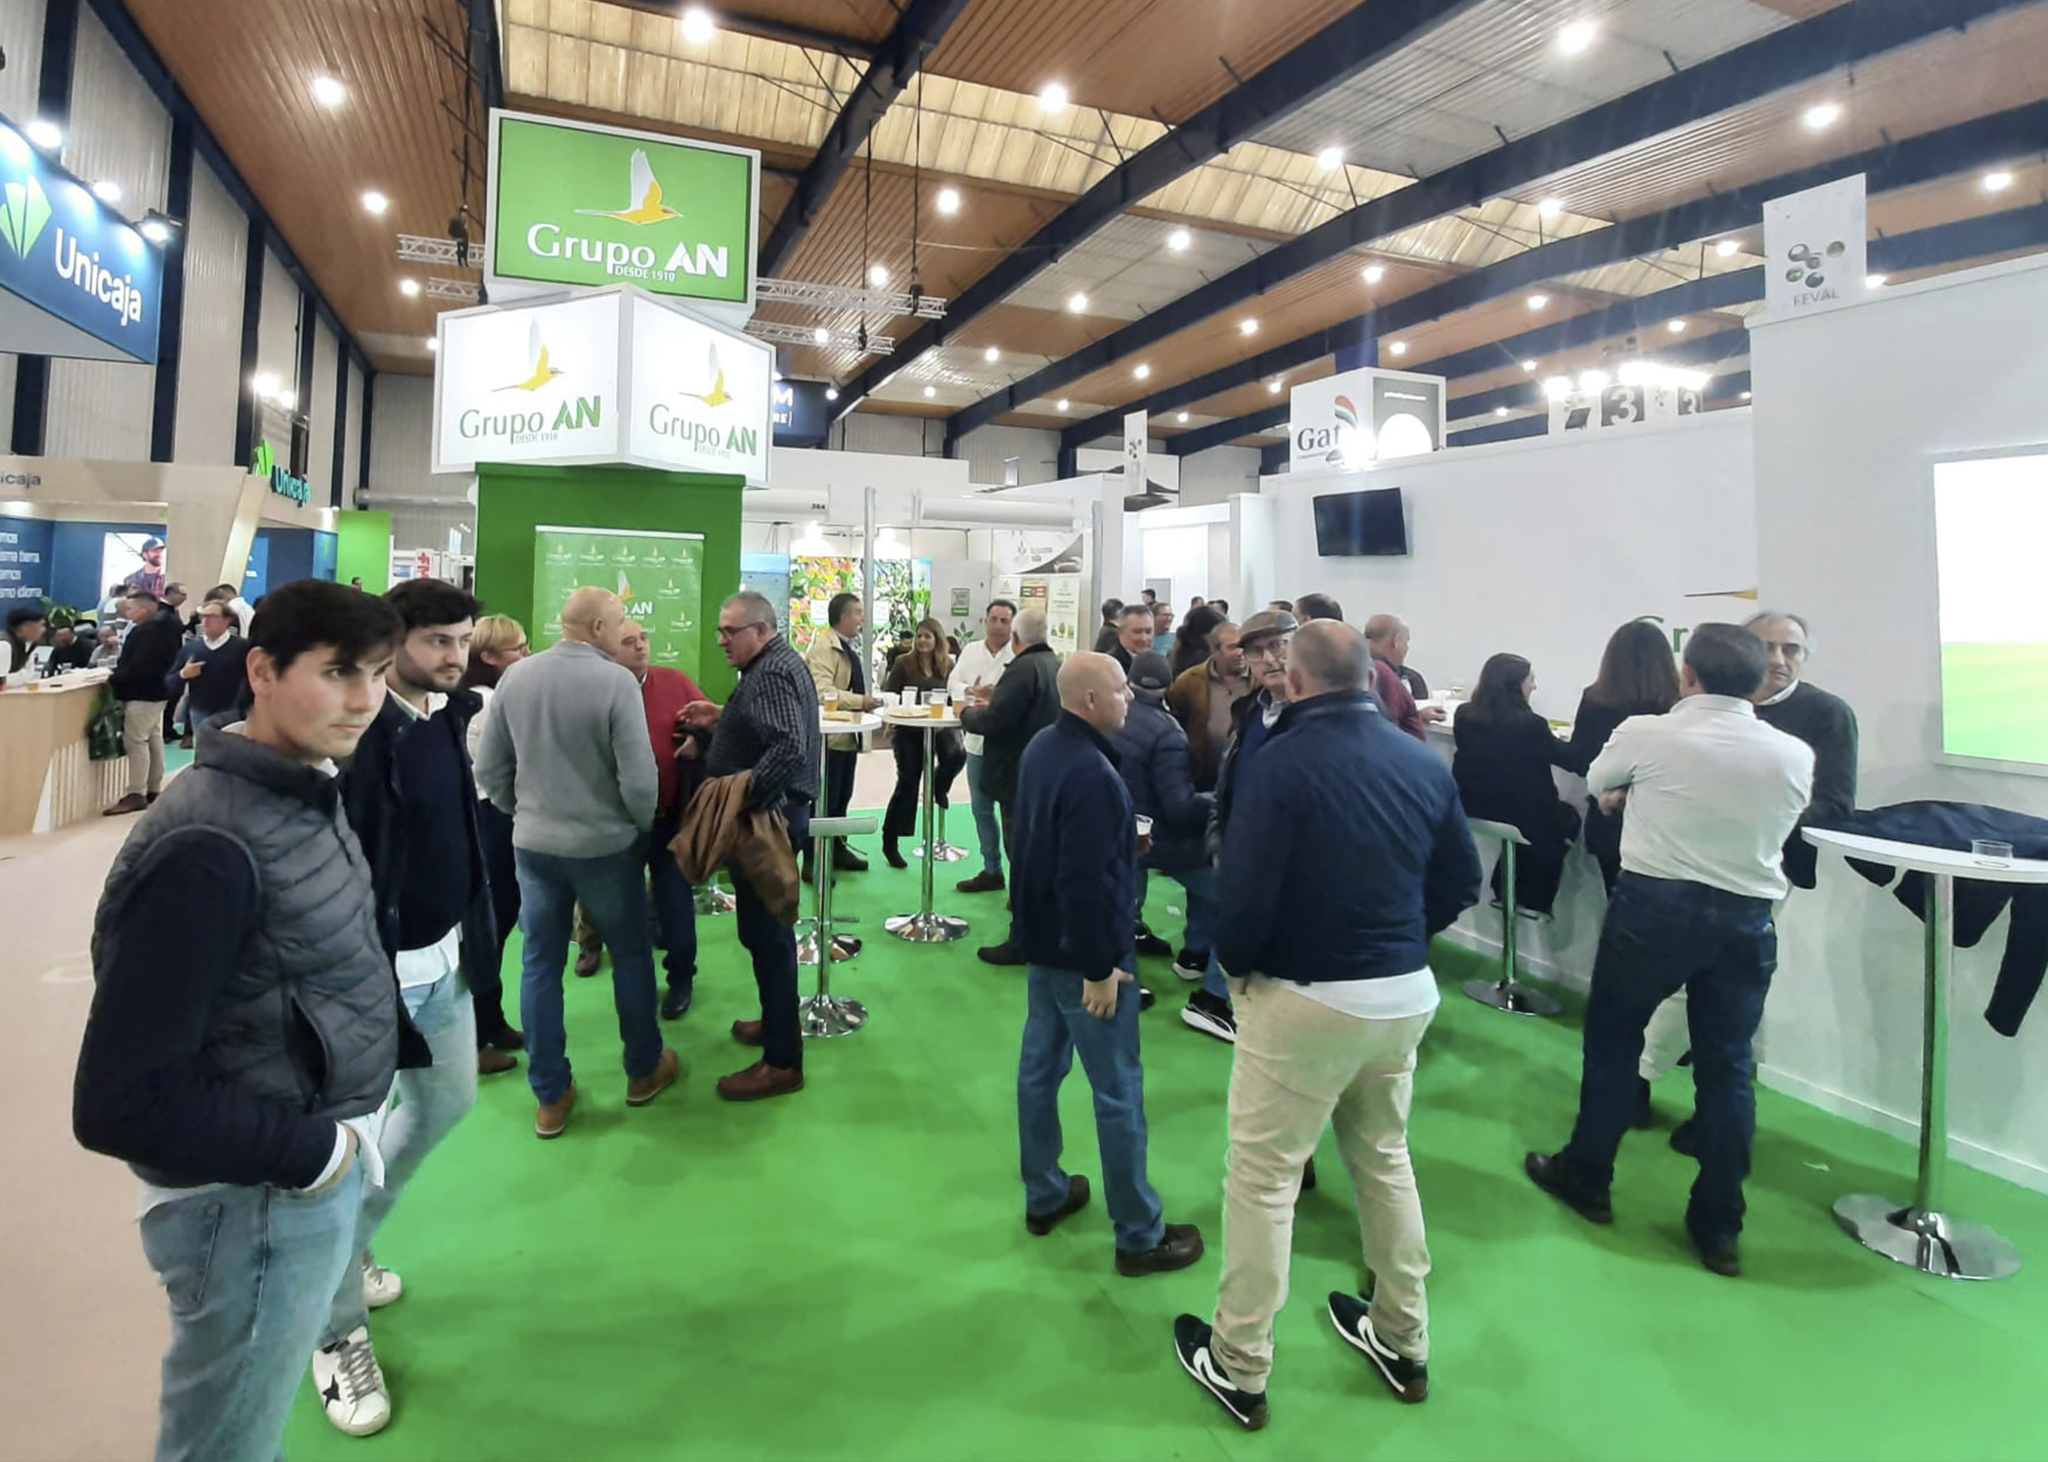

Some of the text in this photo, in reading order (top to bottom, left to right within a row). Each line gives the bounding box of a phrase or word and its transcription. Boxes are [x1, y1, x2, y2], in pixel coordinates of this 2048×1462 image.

[527, 223, 729, 278] Grupo AN
[55, 226, 142, 326] Unicaja
[614, 265, 676, 282] DESDE 1910
[1793, 288, 1840, 307] FEVAL
[459, 395, 601, 445] Grupo AN
[1609, 387, 1638, 425] 3
[649, 403, 757, 456] Grupo AN
[272, 463, 311, 508] Unicaja
[631, 601, 653, 615] AN
